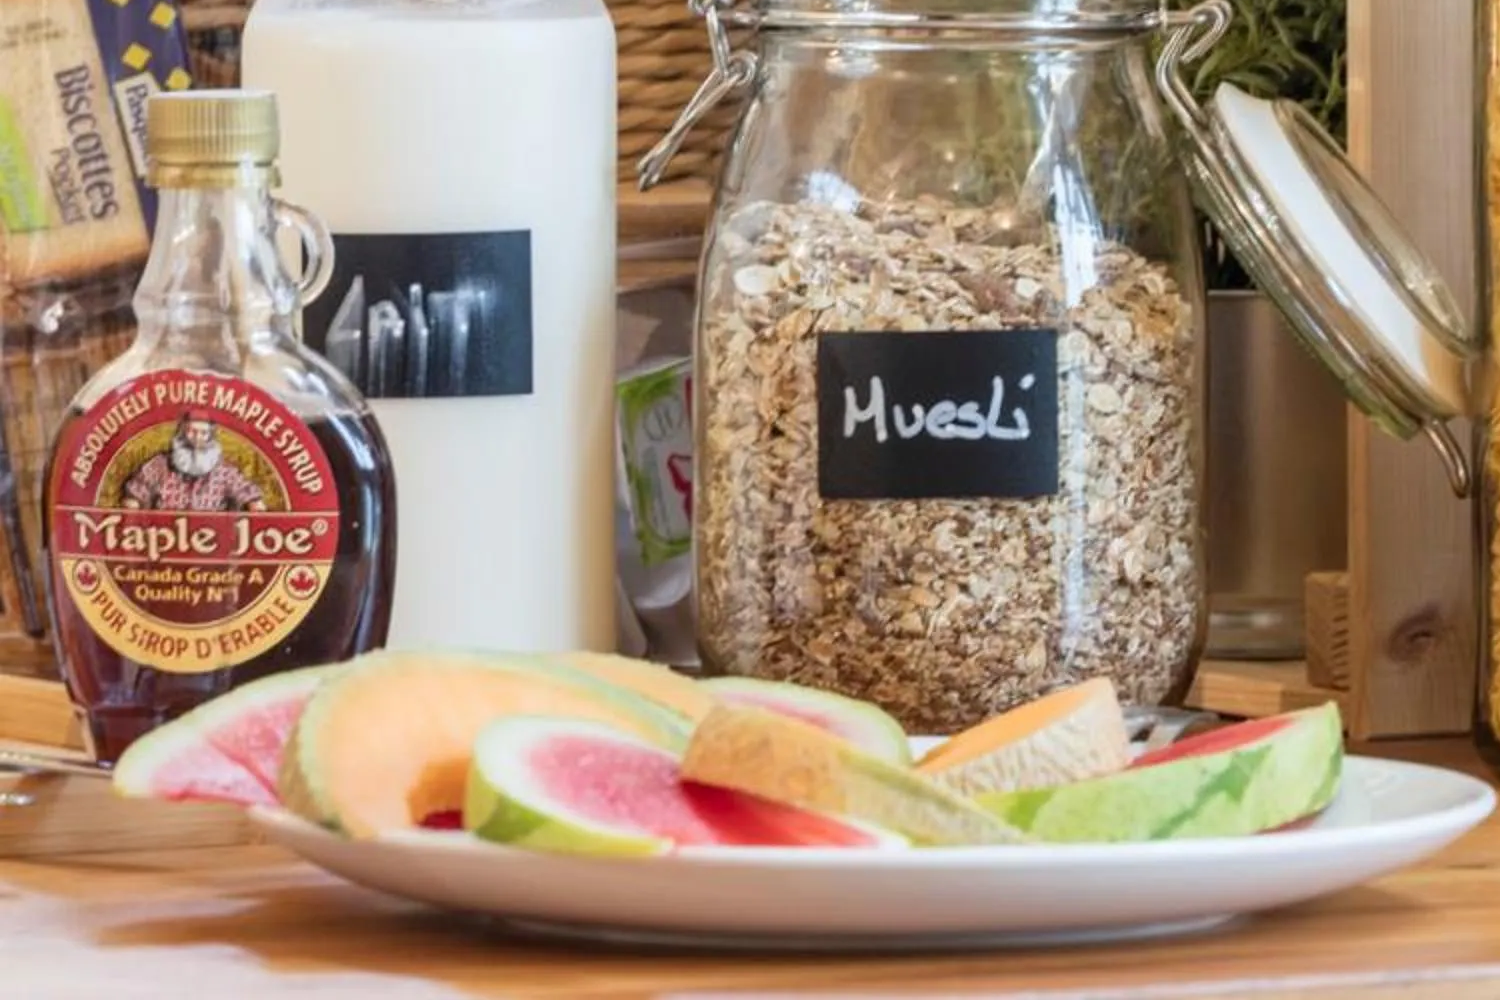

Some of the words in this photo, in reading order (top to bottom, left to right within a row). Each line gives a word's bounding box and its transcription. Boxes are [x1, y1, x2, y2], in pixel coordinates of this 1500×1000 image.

[55, 62, 119, 221] Biscottes
[70, 387, 151, 489] ABSOLUTELY
[154, 379, 208, 405] PURE
[212, 385, 281, 439] MAPLE
[273, 428, 323, 495] SYRUP
[74, 511, 218, 561] Maple
[114, 565, 182, 583] Canada
[186, 565, 244, 583] Grade
[248, 567, 264, 584] A
[135, 585, 201, 606] Quality
[91, 591, 125, 632] PUR
